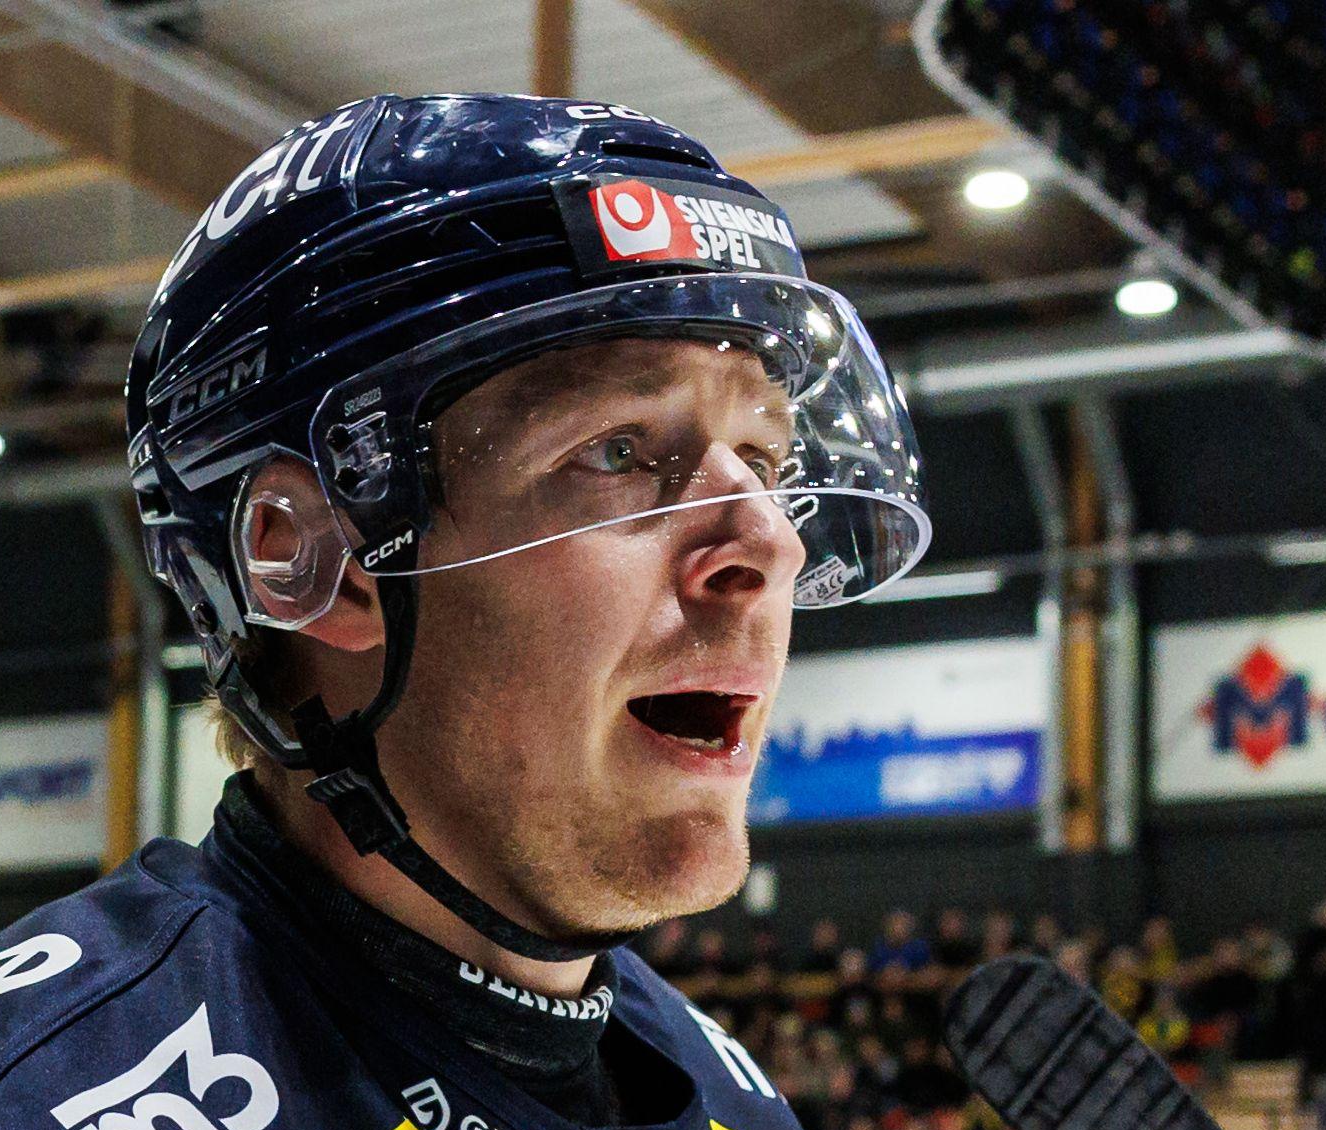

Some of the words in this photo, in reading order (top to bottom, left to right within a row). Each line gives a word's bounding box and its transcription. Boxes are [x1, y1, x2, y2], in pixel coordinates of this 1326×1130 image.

[673, 195, 798, 253] SVENSKA
[691, 225, 761, 269] SPEL
[169, 347, 269, 424] CCM
[364, 529, 413, 568] CCM
